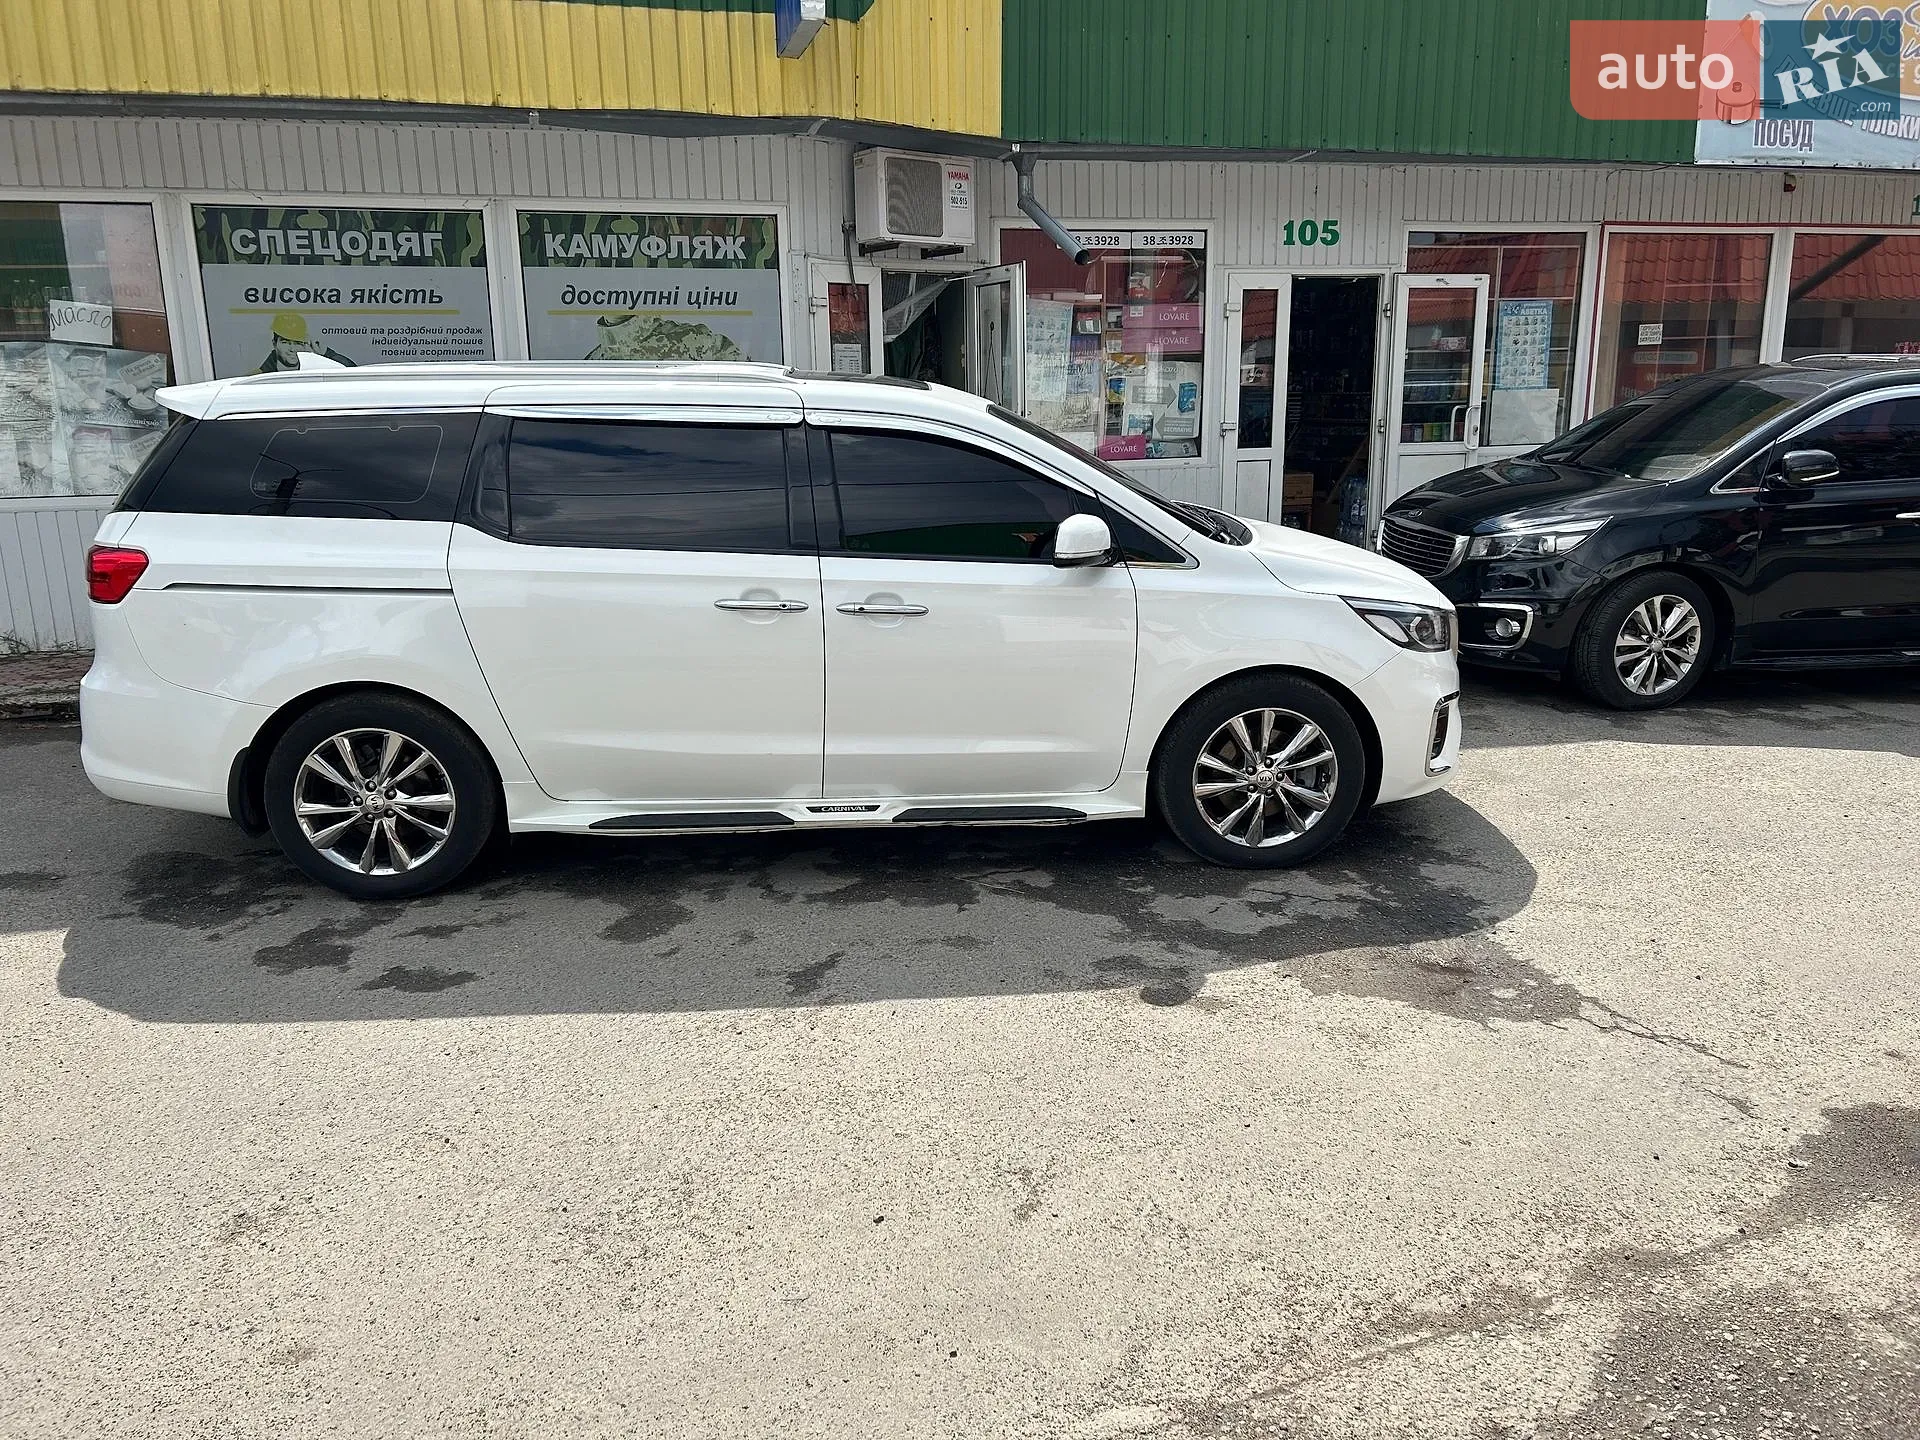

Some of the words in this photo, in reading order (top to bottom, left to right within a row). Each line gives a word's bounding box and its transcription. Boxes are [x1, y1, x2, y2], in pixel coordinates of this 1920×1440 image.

[1753, 119, 1814, 152] ПОСУД
[948, 171, 970, 181] YAMAHA
[1283, 219, 1340, 246] 105
[231, 229, 442, 261] СПЕЦОДЯГ
[545, 233, 747, 259] КАМУФЛЯЖ
[244, 287, 341, 304] висока
[350, 283, 443, 305] якість
[561, 285, 680, 310] доступні
[687, 286, 738, 309] ціни
[321, 326, 368, 335] оптовий
[387, 326, 443, 336] роздрібний
[446, 326, 483, 336] продаж
[371, 336, 448, 346] індивідуальний
[450, 338, 483, 346] пошив
[381, 348, 417, 357] повний
[419, 349, 484, 358] асортимент
[1110, 445, 1137, 453] LOVARE
